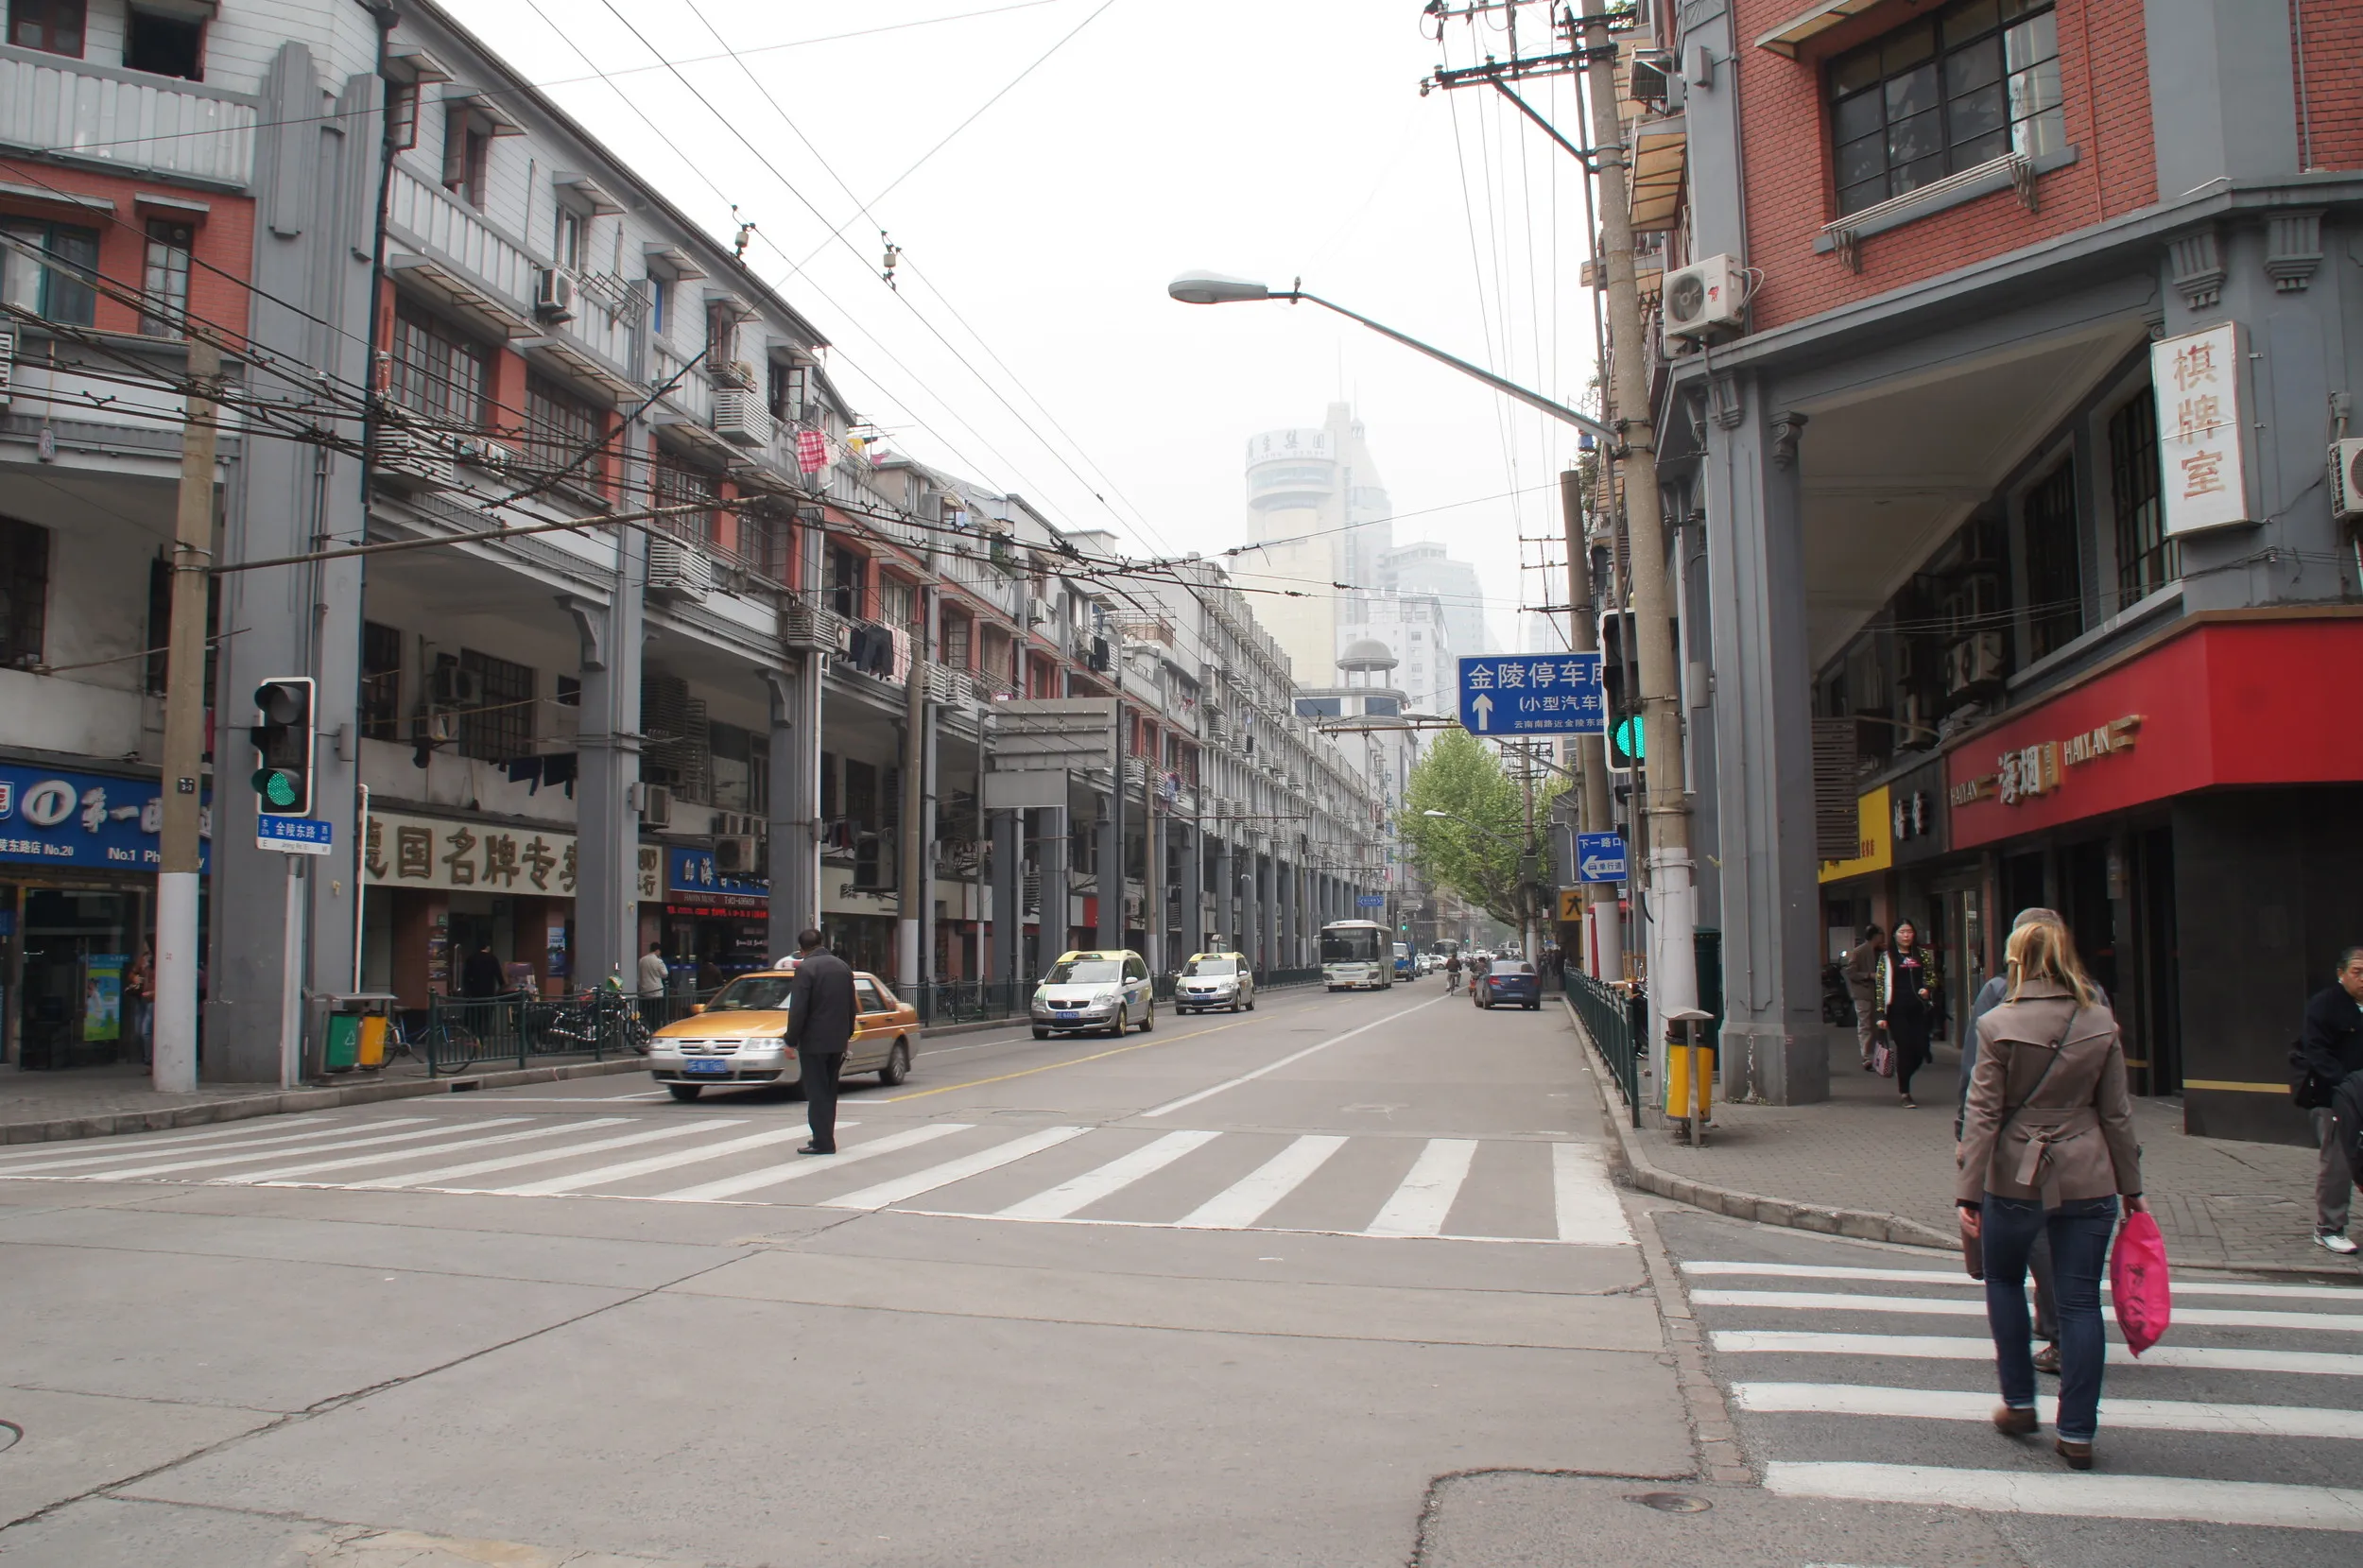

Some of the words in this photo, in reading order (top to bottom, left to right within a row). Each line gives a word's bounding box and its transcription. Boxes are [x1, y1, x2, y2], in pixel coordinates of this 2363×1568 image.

[2172, 340, 2226, 501] 棋牌室
[2063, 725, 2111, 767] HAIYAN
[1950, 779, 1979, 807] HAIYAN
[276, 822, 316, 838] 金陵东路
[43, 844, 74, 857] No.20
[1579, 836, 1621, 850] 下一路口
[107, 847, 136, 862] No.1
